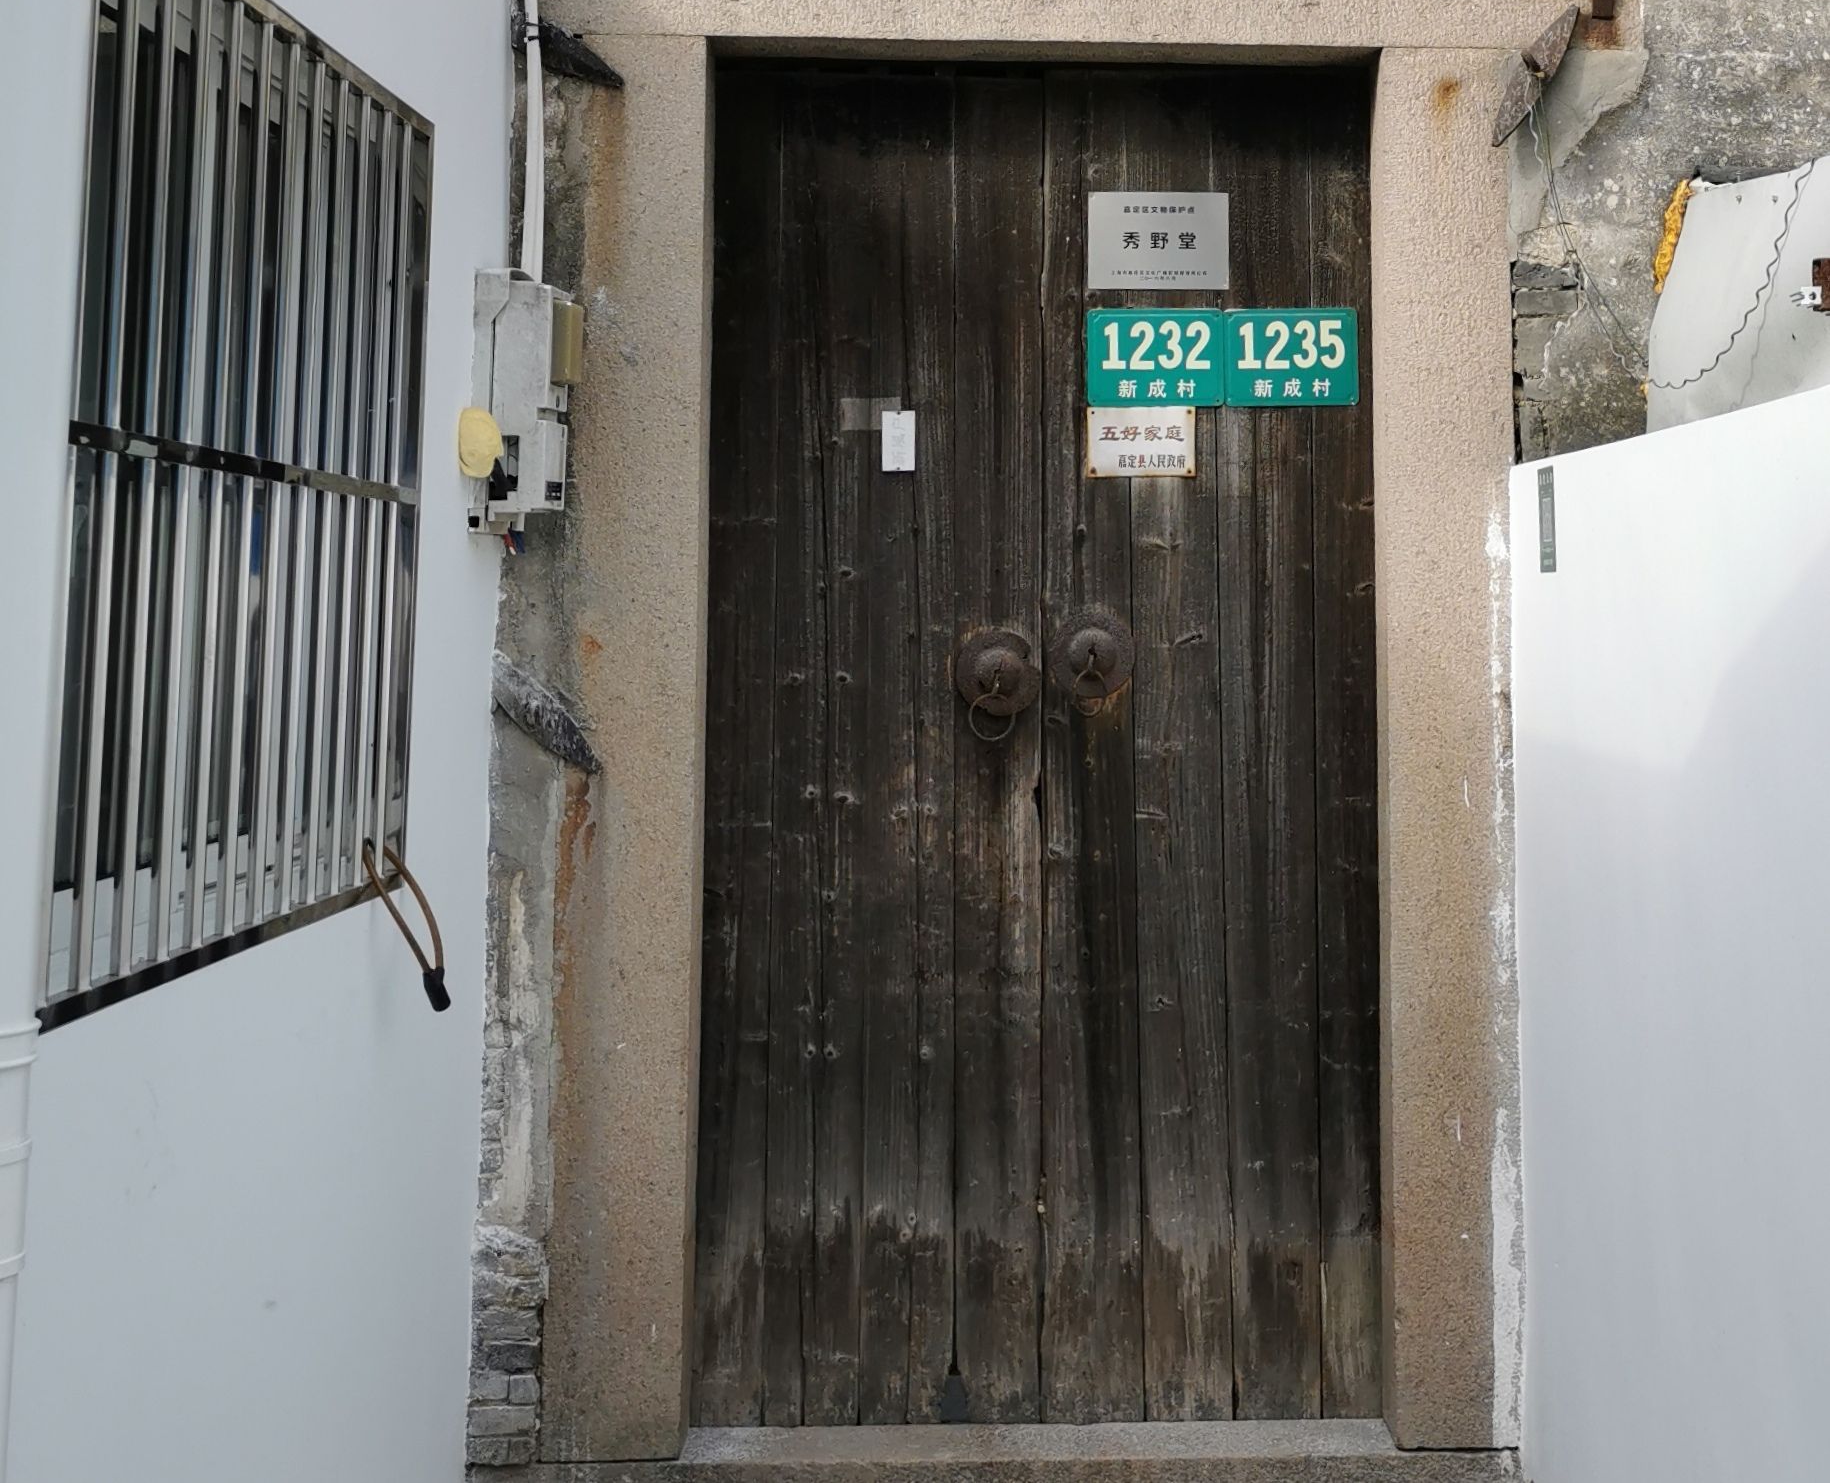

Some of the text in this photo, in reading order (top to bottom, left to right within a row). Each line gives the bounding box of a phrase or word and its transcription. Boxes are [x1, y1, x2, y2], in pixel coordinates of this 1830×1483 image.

[1122, 231, 1197, 250] 秀野堂
[1102, 320, 1211, 370] 1232
[1238, 320, 1345, 370] 1235
[1118, 379, 1196, 398] 新成村
[1254, 379, 1331, 398] 新成村
[1099, 425, 1185, 442] 五好家庭
[1118, 454, 1186, 469] 嘉定县人民政府
